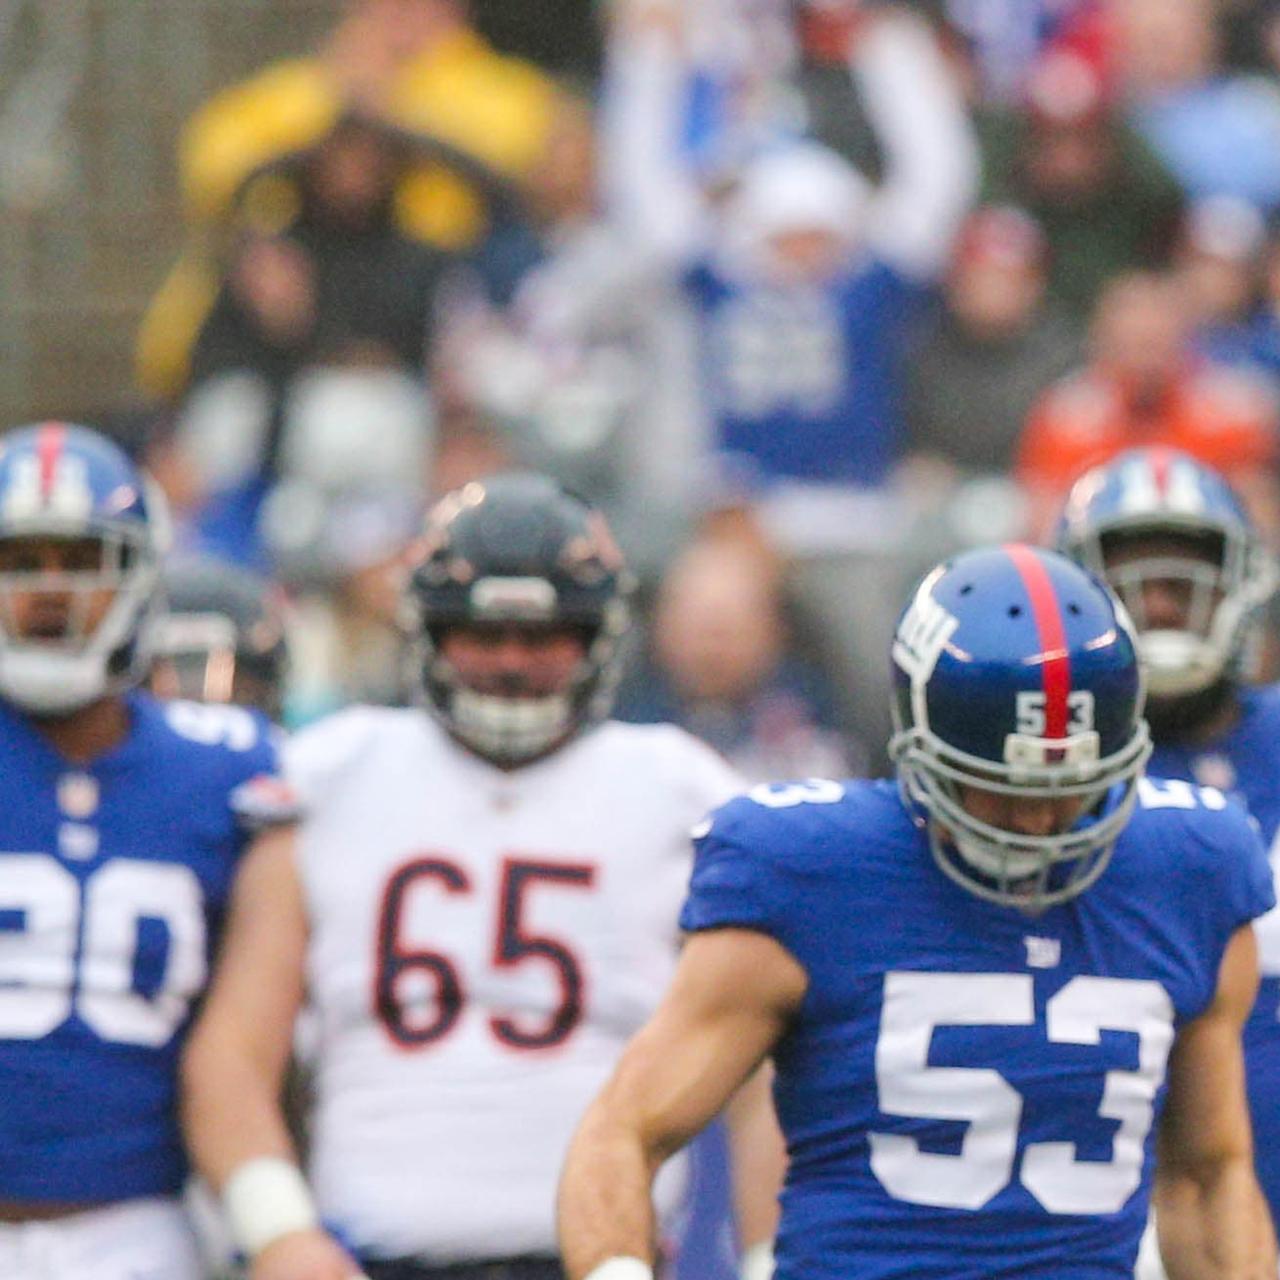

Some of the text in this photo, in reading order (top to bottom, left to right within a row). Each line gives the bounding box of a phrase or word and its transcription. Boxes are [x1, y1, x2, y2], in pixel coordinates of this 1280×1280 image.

[1015, 690, 1096, 735] 53
[375, 857, 596, 1052] 65
[866, 970, 1176, 1215] 53
